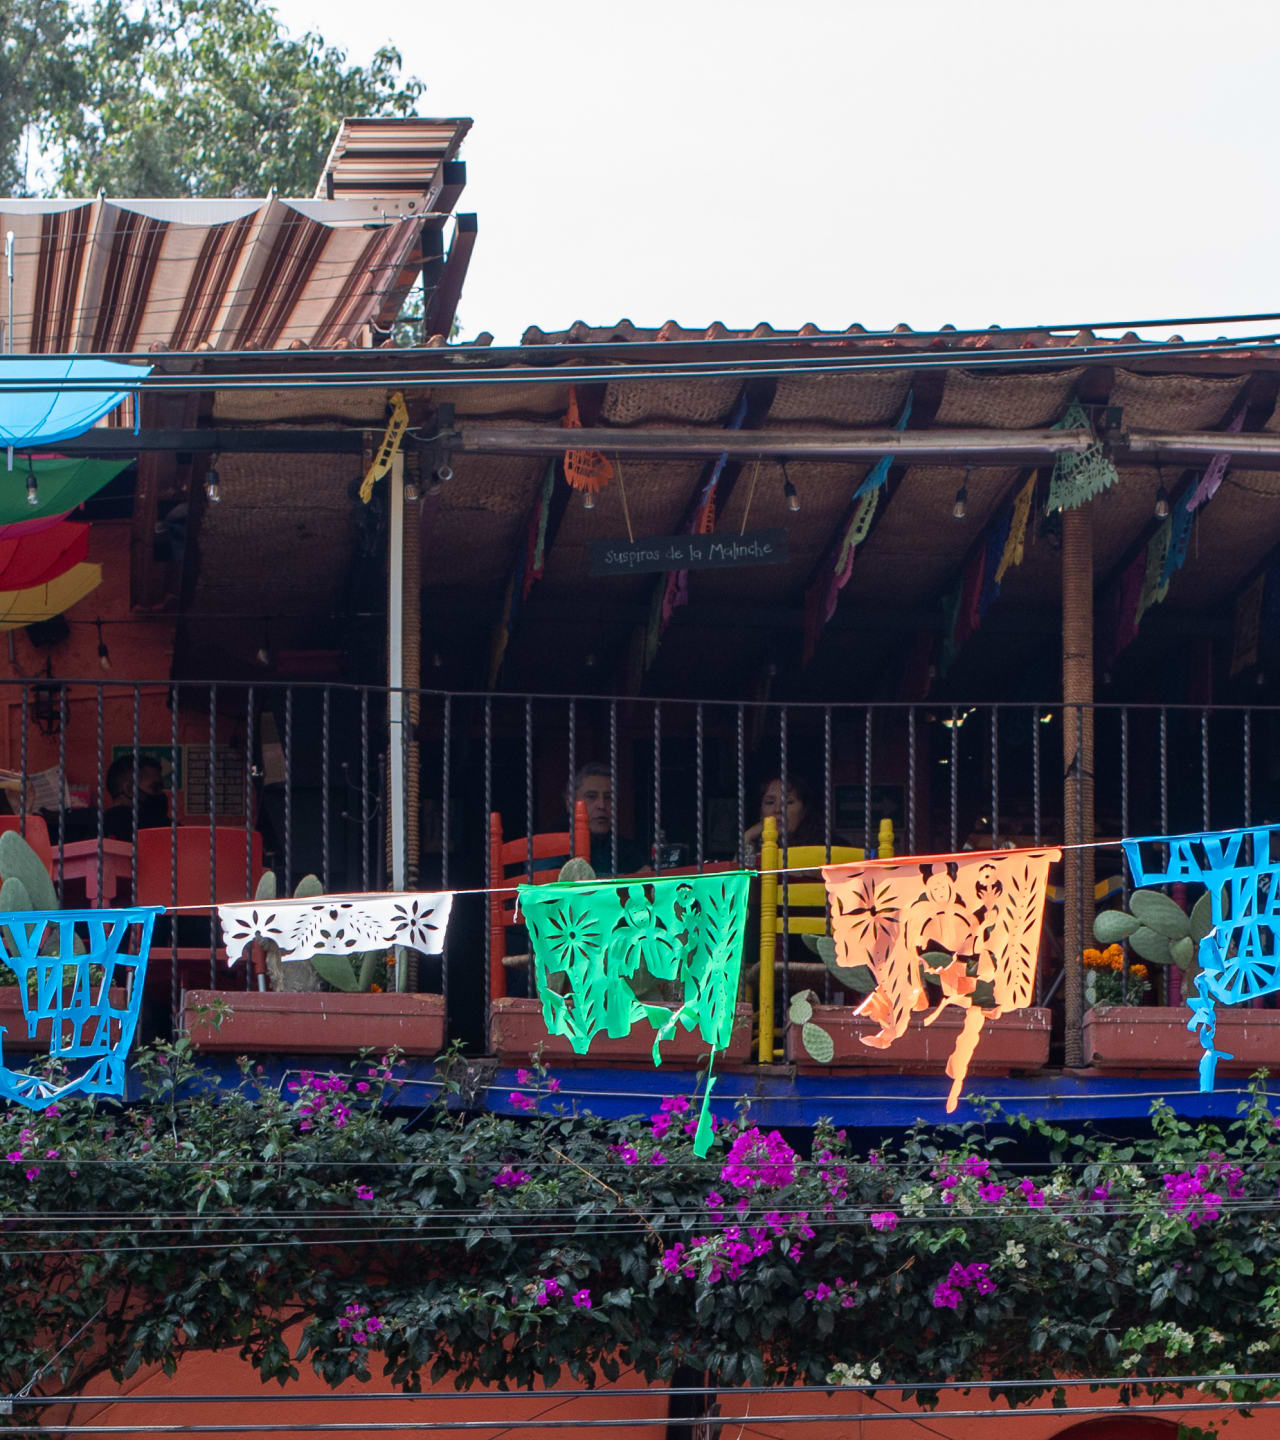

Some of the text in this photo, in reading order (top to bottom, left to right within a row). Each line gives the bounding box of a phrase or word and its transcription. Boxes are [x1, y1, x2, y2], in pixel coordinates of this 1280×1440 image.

[665, 547, 684, 561] de
[689, 545, 702, 560] la
[708, 541, 774, 561] Malinche
